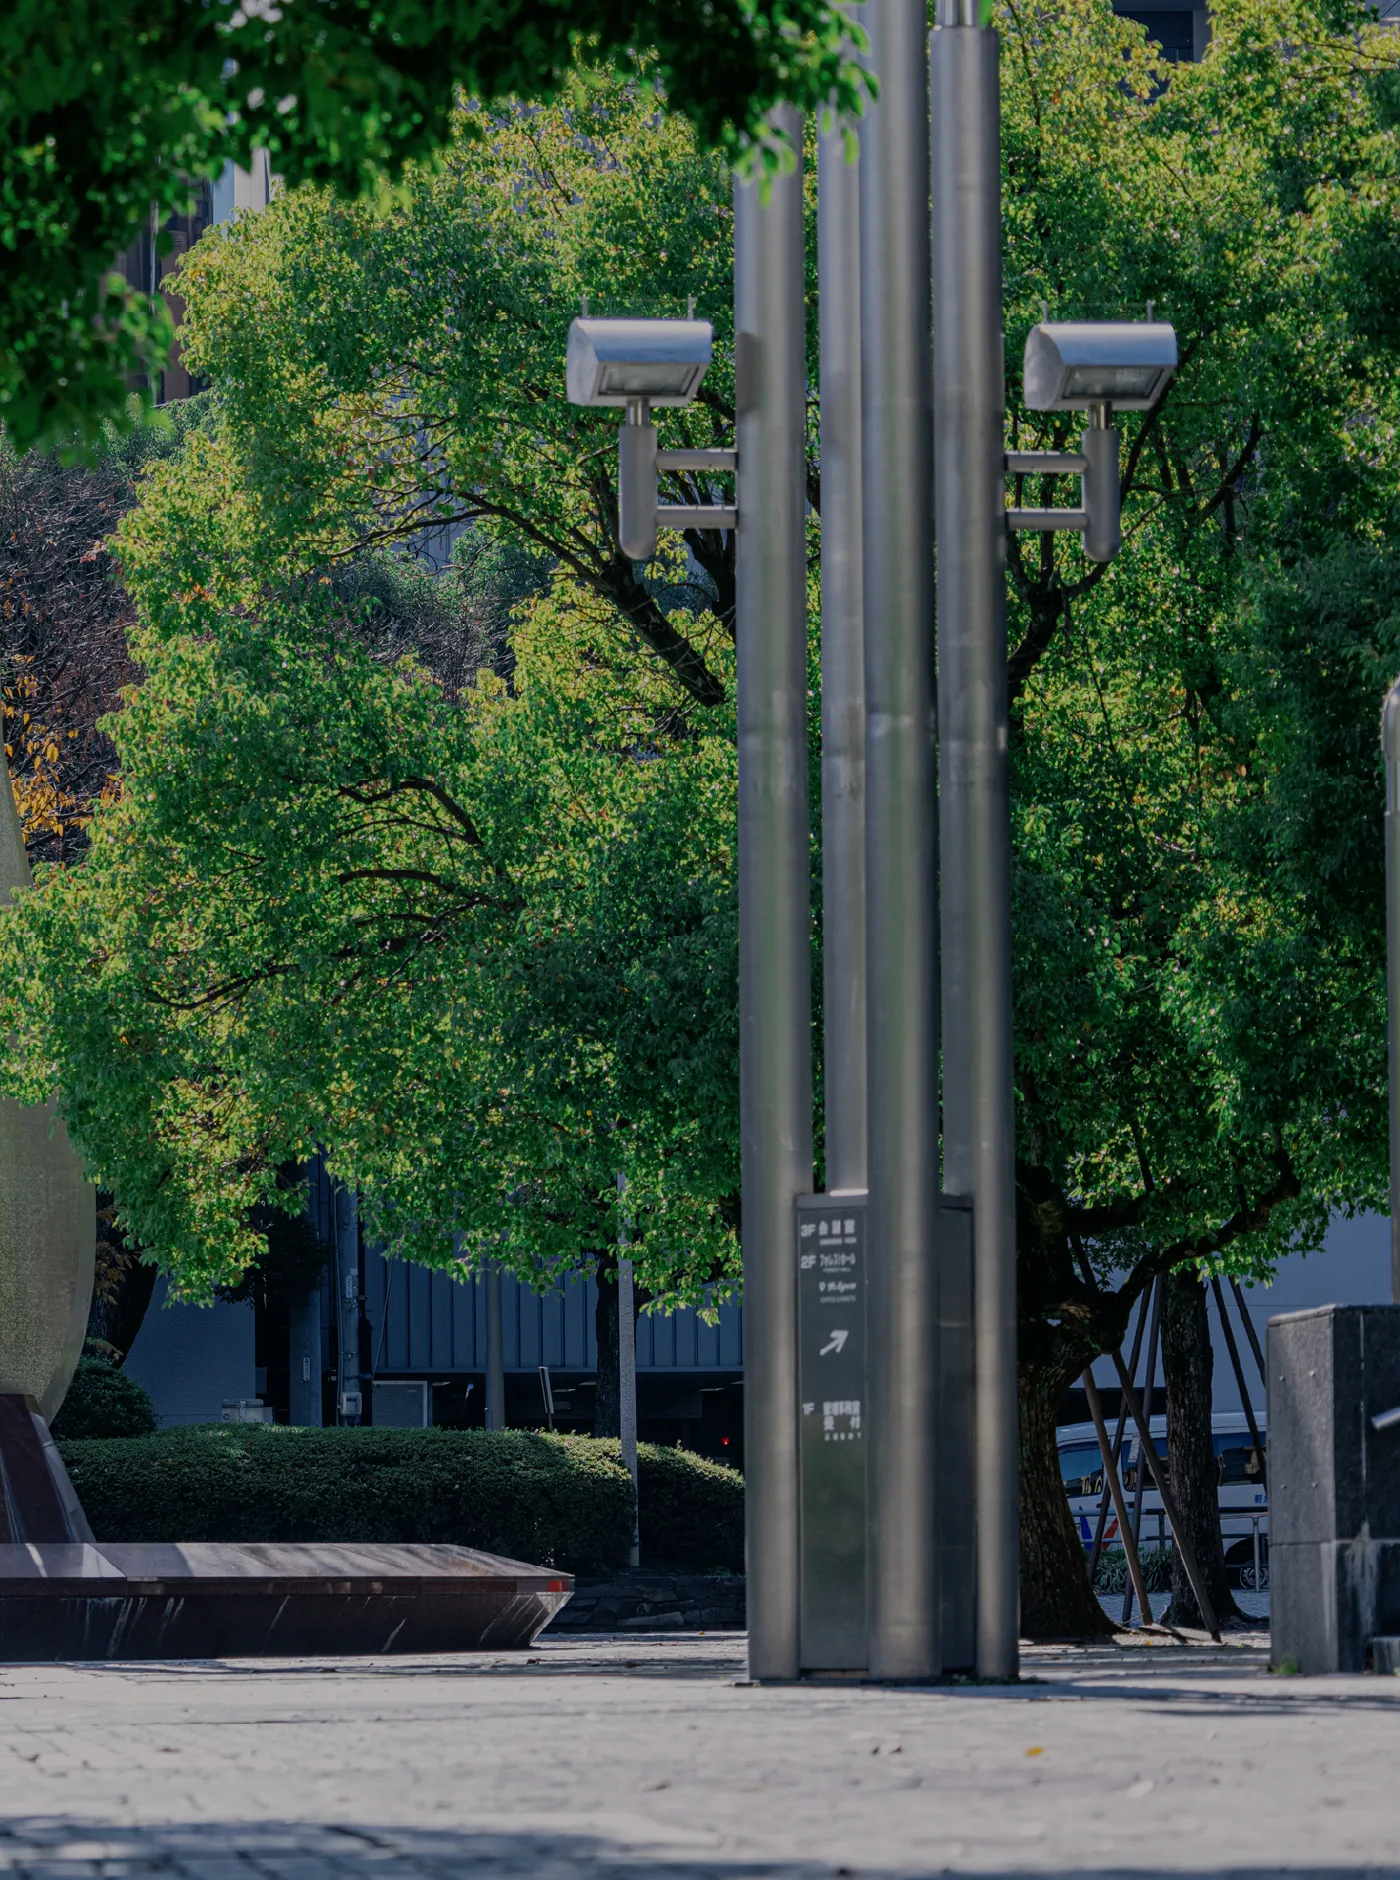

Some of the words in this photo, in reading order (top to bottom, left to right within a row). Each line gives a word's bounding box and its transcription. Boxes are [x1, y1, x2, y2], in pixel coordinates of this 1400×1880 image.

[800, 1223, 816, 1238] 3F
[800, 1254, 817, 1269] 2F
[802, 1402, 815, 1416] 1F
